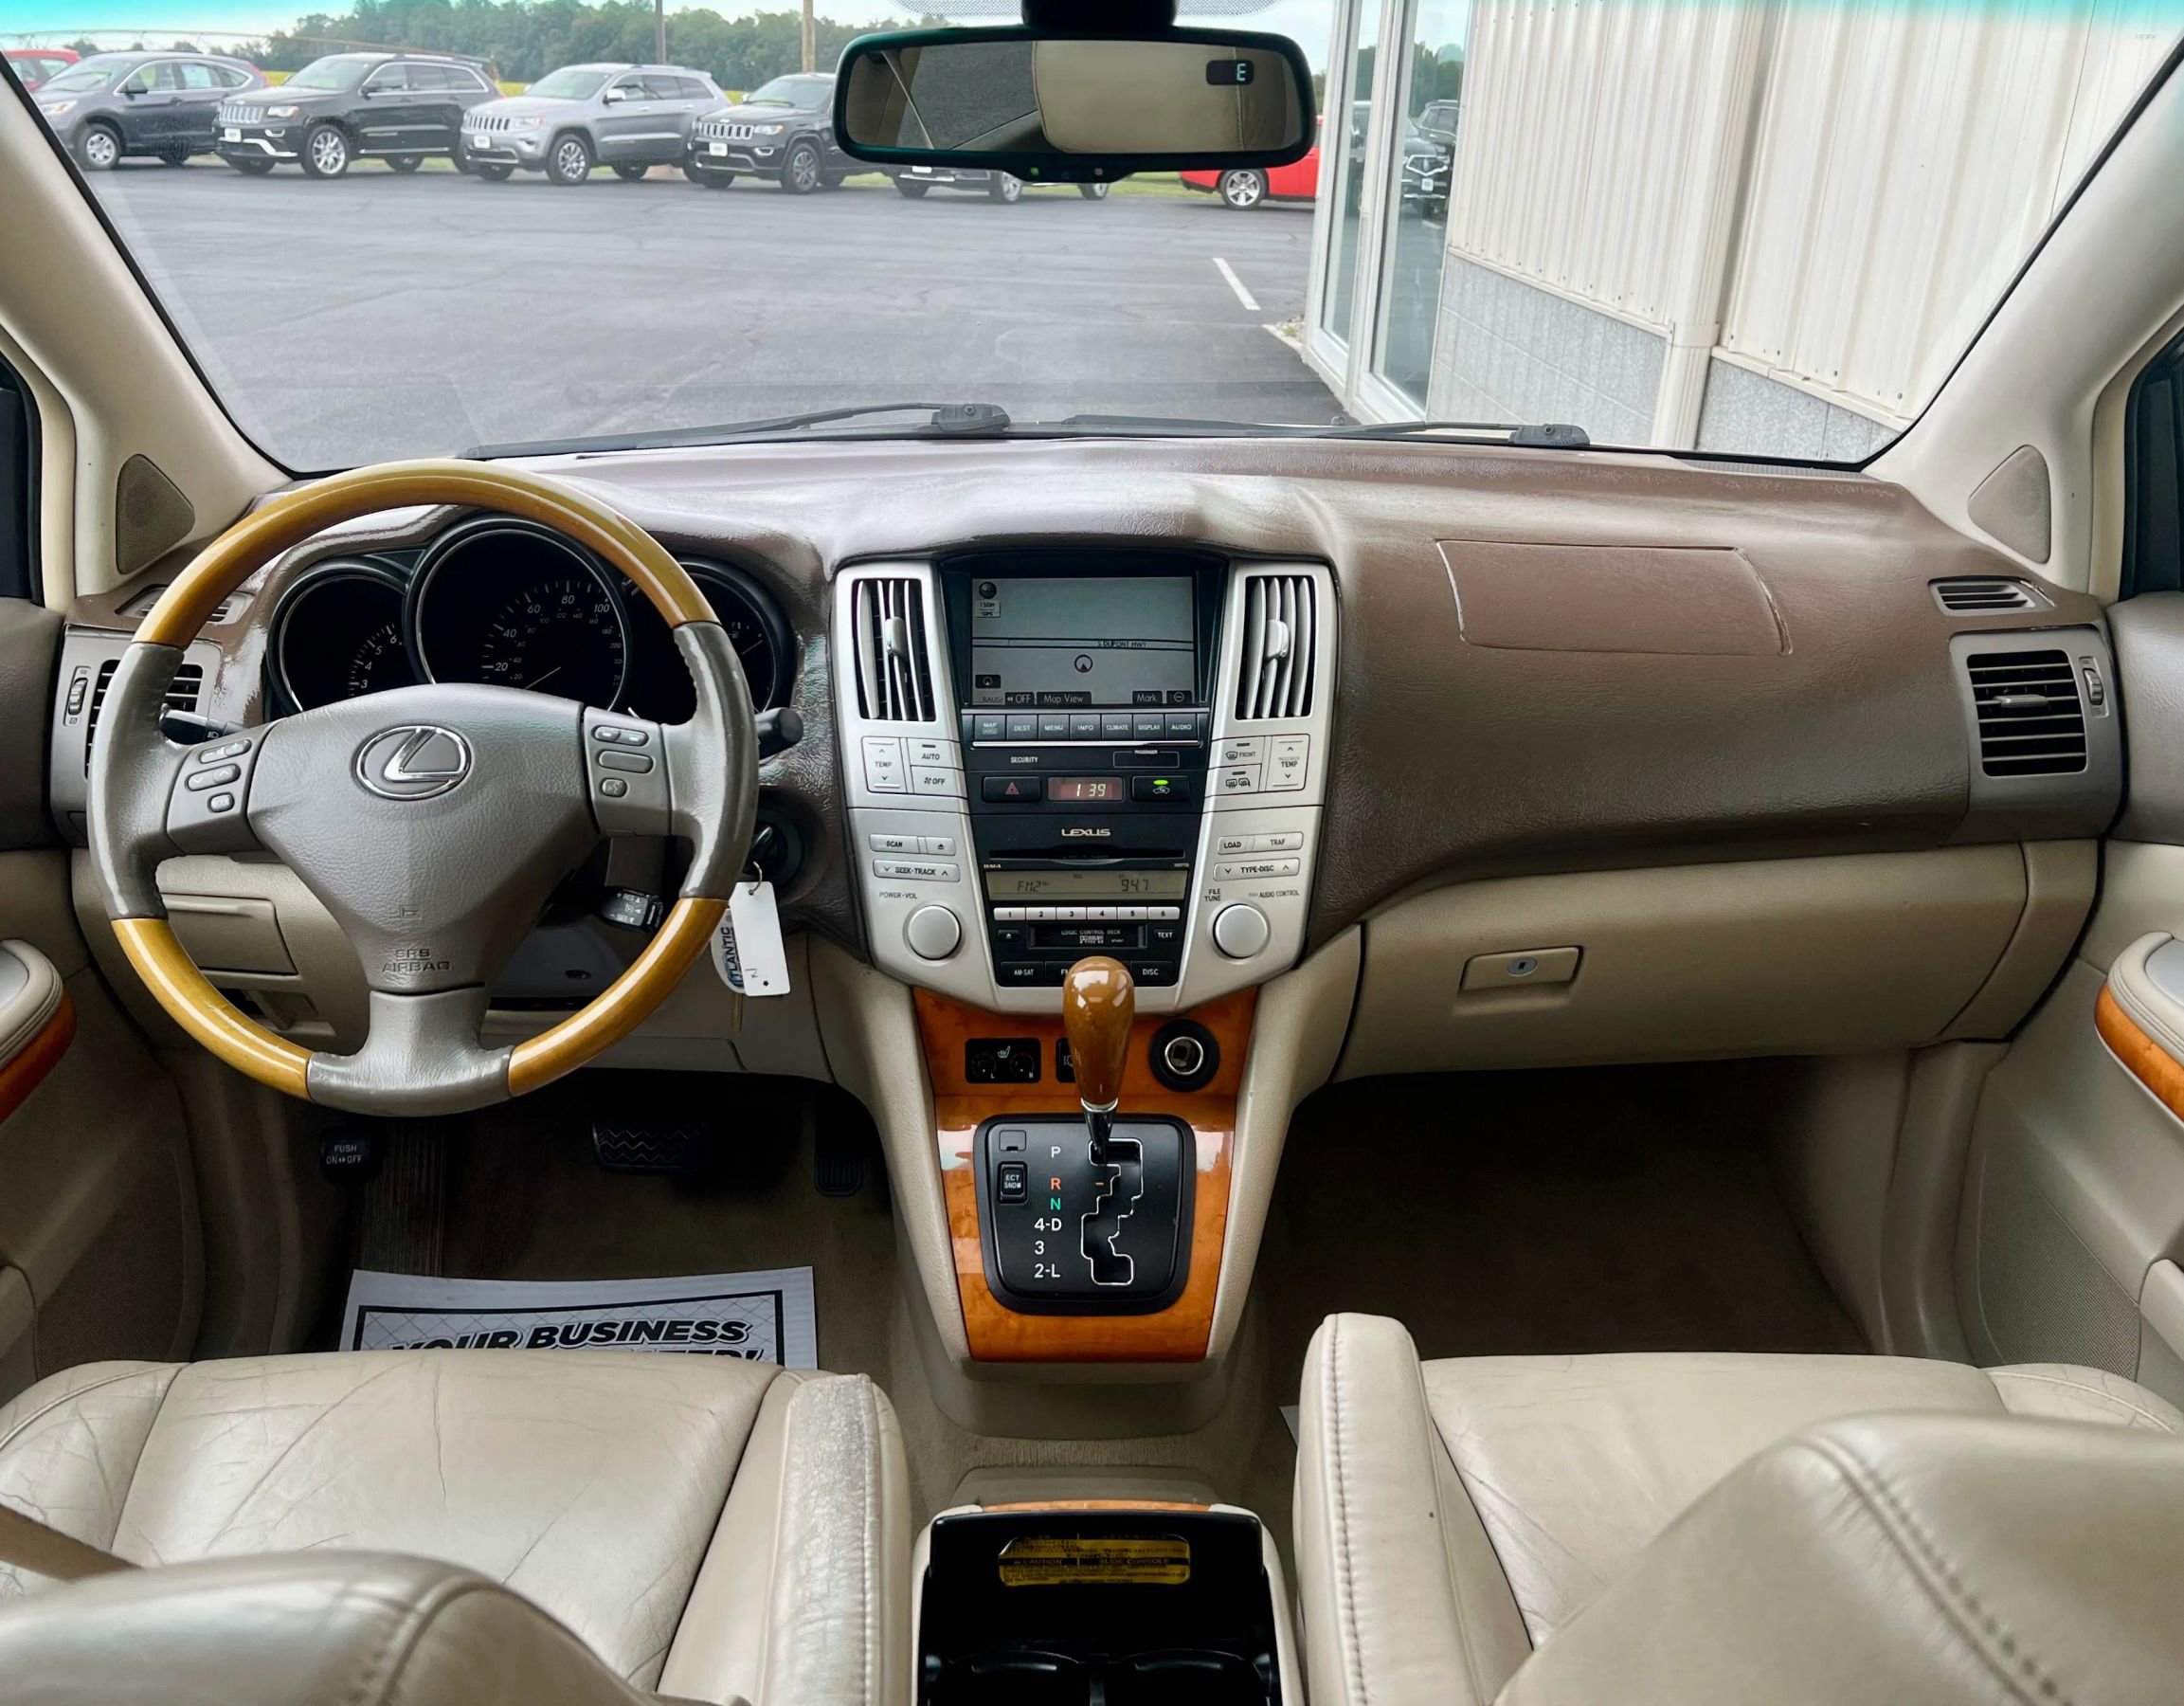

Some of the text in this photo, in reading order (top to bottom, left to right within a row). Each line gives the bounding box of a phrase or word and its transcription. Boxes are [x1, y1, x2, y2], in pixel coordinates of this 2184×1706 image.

[1236, 63, 1246, 82] E
[561, 594, 575, 605] 80
[527, 604, 541, 613] 60
[593, 603, 610, 613] 100
[502, 628, 517, 638] 40
[389, 634, 397, 644] 6
[364, 661, 372, 671] 4
[494, 662, 509, 672] 20
[360, 679, 369, 689] 3
[1015, 694, 1032, 703] OFF
[1043, 693, 1084, 704] Map View
[1137, 693, 1157, 701] Mark
[875, 760, 893, 769] TEMP
[1061, 828, 1110, 837] LEXUS
[1270, 838, 1286, 846] TRAF
[1259, 890, 1275, 898] AUDIO
[1275, 888, 1299, 898] CONTROL
[395, 948, 431, 958] SRS
[381, 960, 451, 972] AIRBAG
[334, 1144, 357, 1153] PUSH
[1050, 1145, 1061, 1158] P
[326, 1154, 362, 1165] ON OFF
[1050, 1177, 1061, 1190] R
[1050, 1197, 1061, 1210] N
[1034, 1218, 1062, 1232] 4-D
[1034, 1241, 1044, 1255] 3
[1034, 1264, 1061, 1279] 2-L
[391, 1320, 749, 1350] UR BUSINESS
